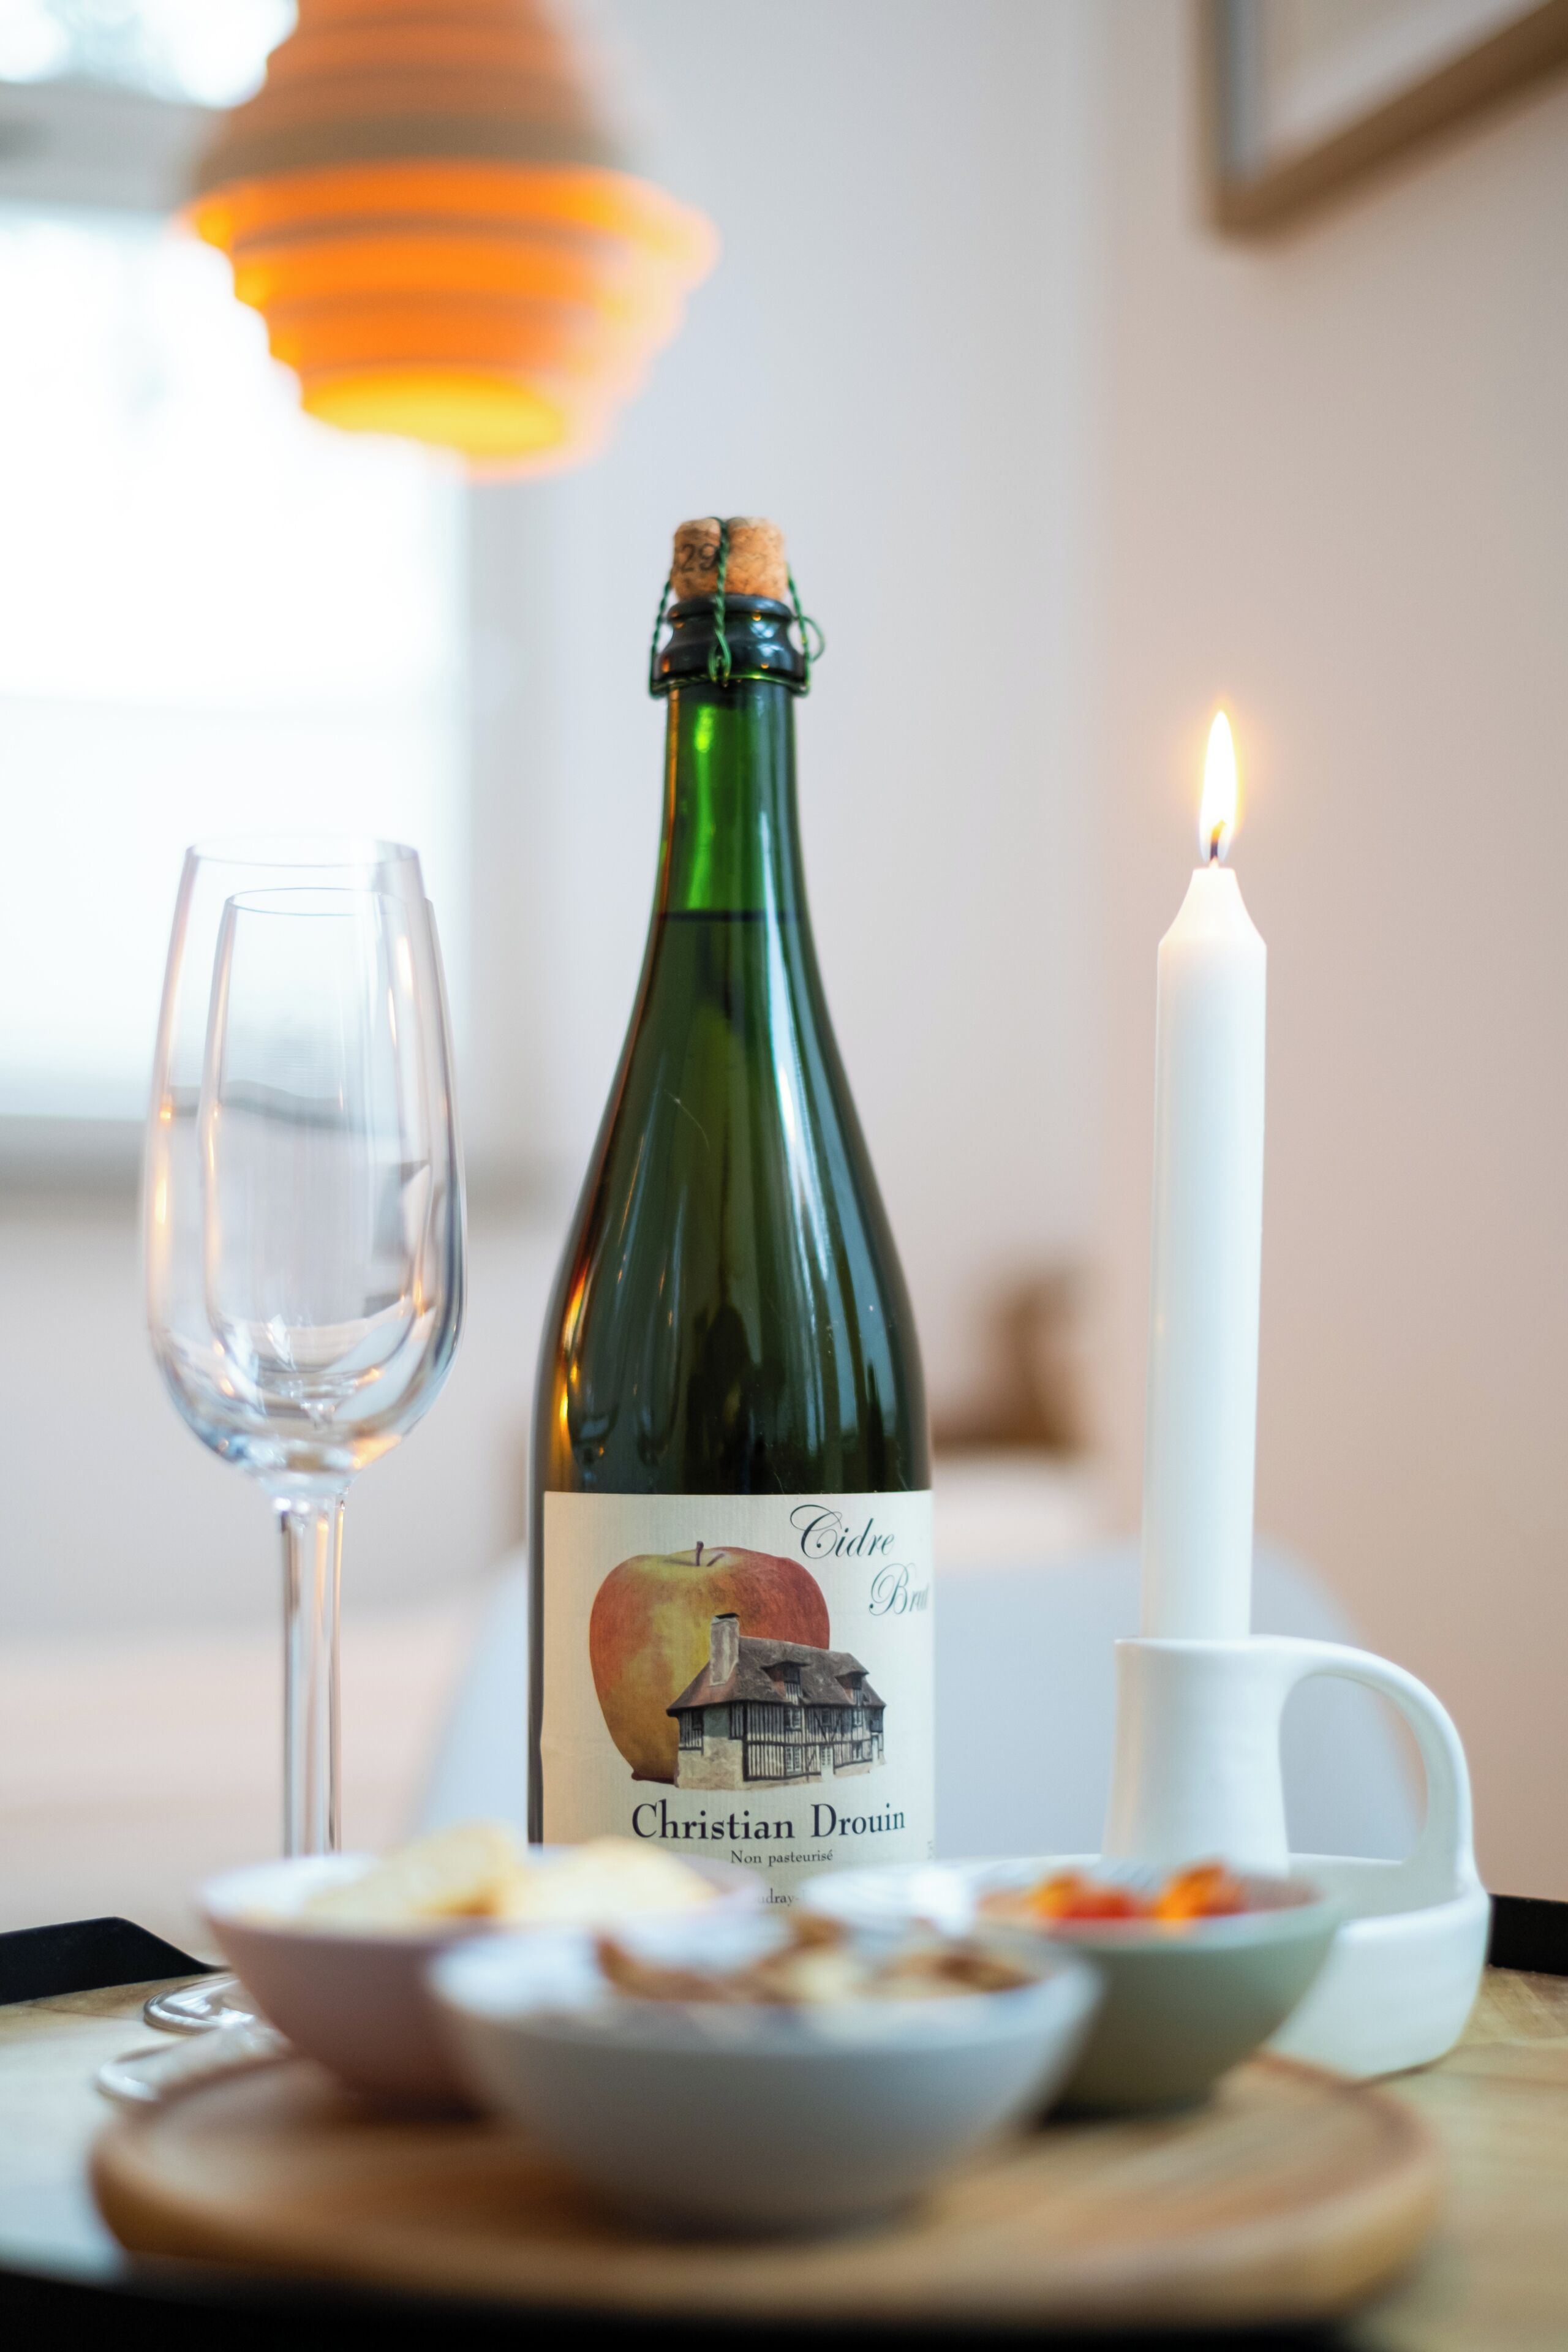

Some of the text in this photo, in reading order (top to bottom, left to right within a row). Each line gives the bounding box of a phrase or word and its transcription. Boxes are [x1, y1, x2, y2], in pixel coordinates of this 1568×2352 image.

[790, 1504, 895, 1559] Cidre
[631, 1798, 905, 1840] Christian Drouin
[731, 1849, 834, 1867] Non pasteurisé
